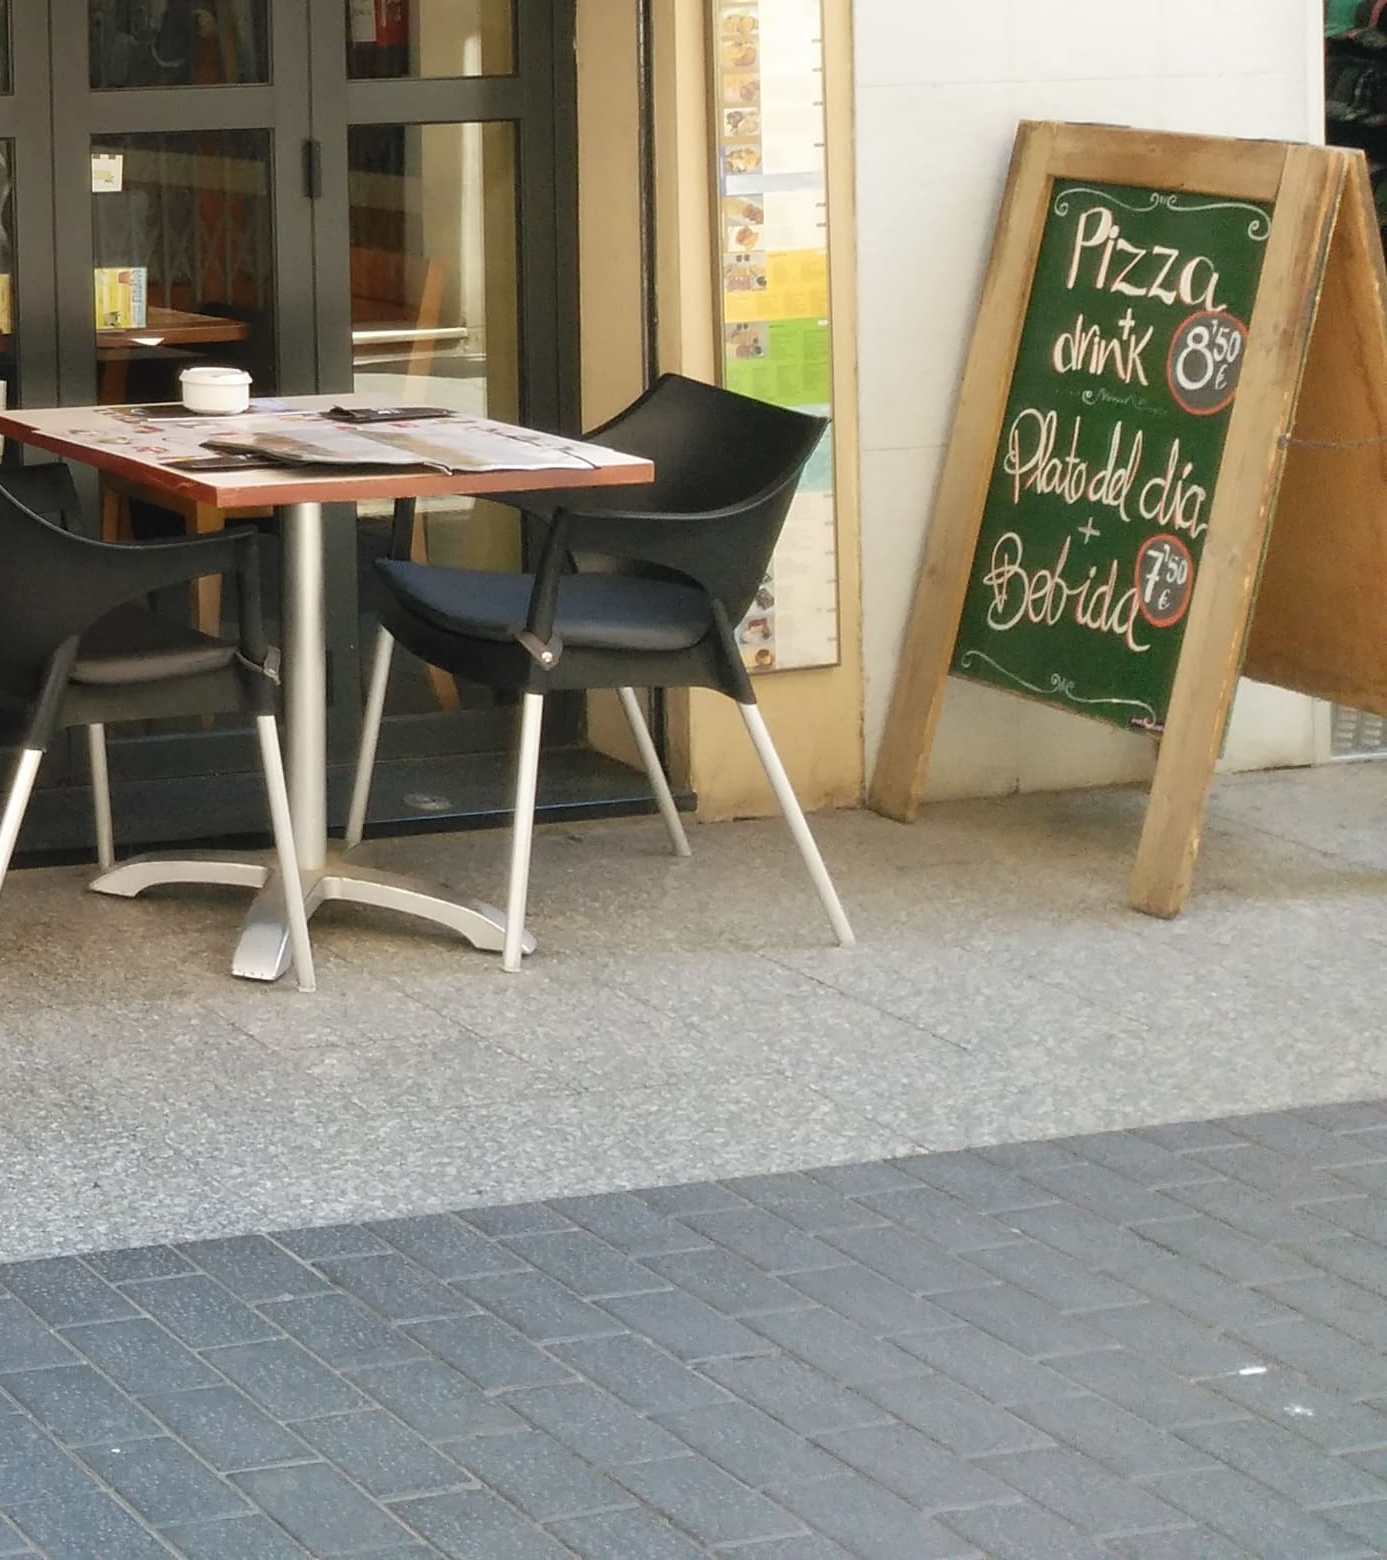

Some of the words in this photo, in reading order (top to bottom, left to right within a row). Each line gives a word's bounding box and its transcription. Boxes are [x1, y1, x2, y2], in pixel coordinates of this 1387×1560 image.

[1066, 206, 1227, 312] Pizza
[1053, 313, 1155, 387] drink
[1003, 408, 1087, 505] Plato
[1088, 420, 1141, 523] del
[983, 532, 1151, 653] Bebida
